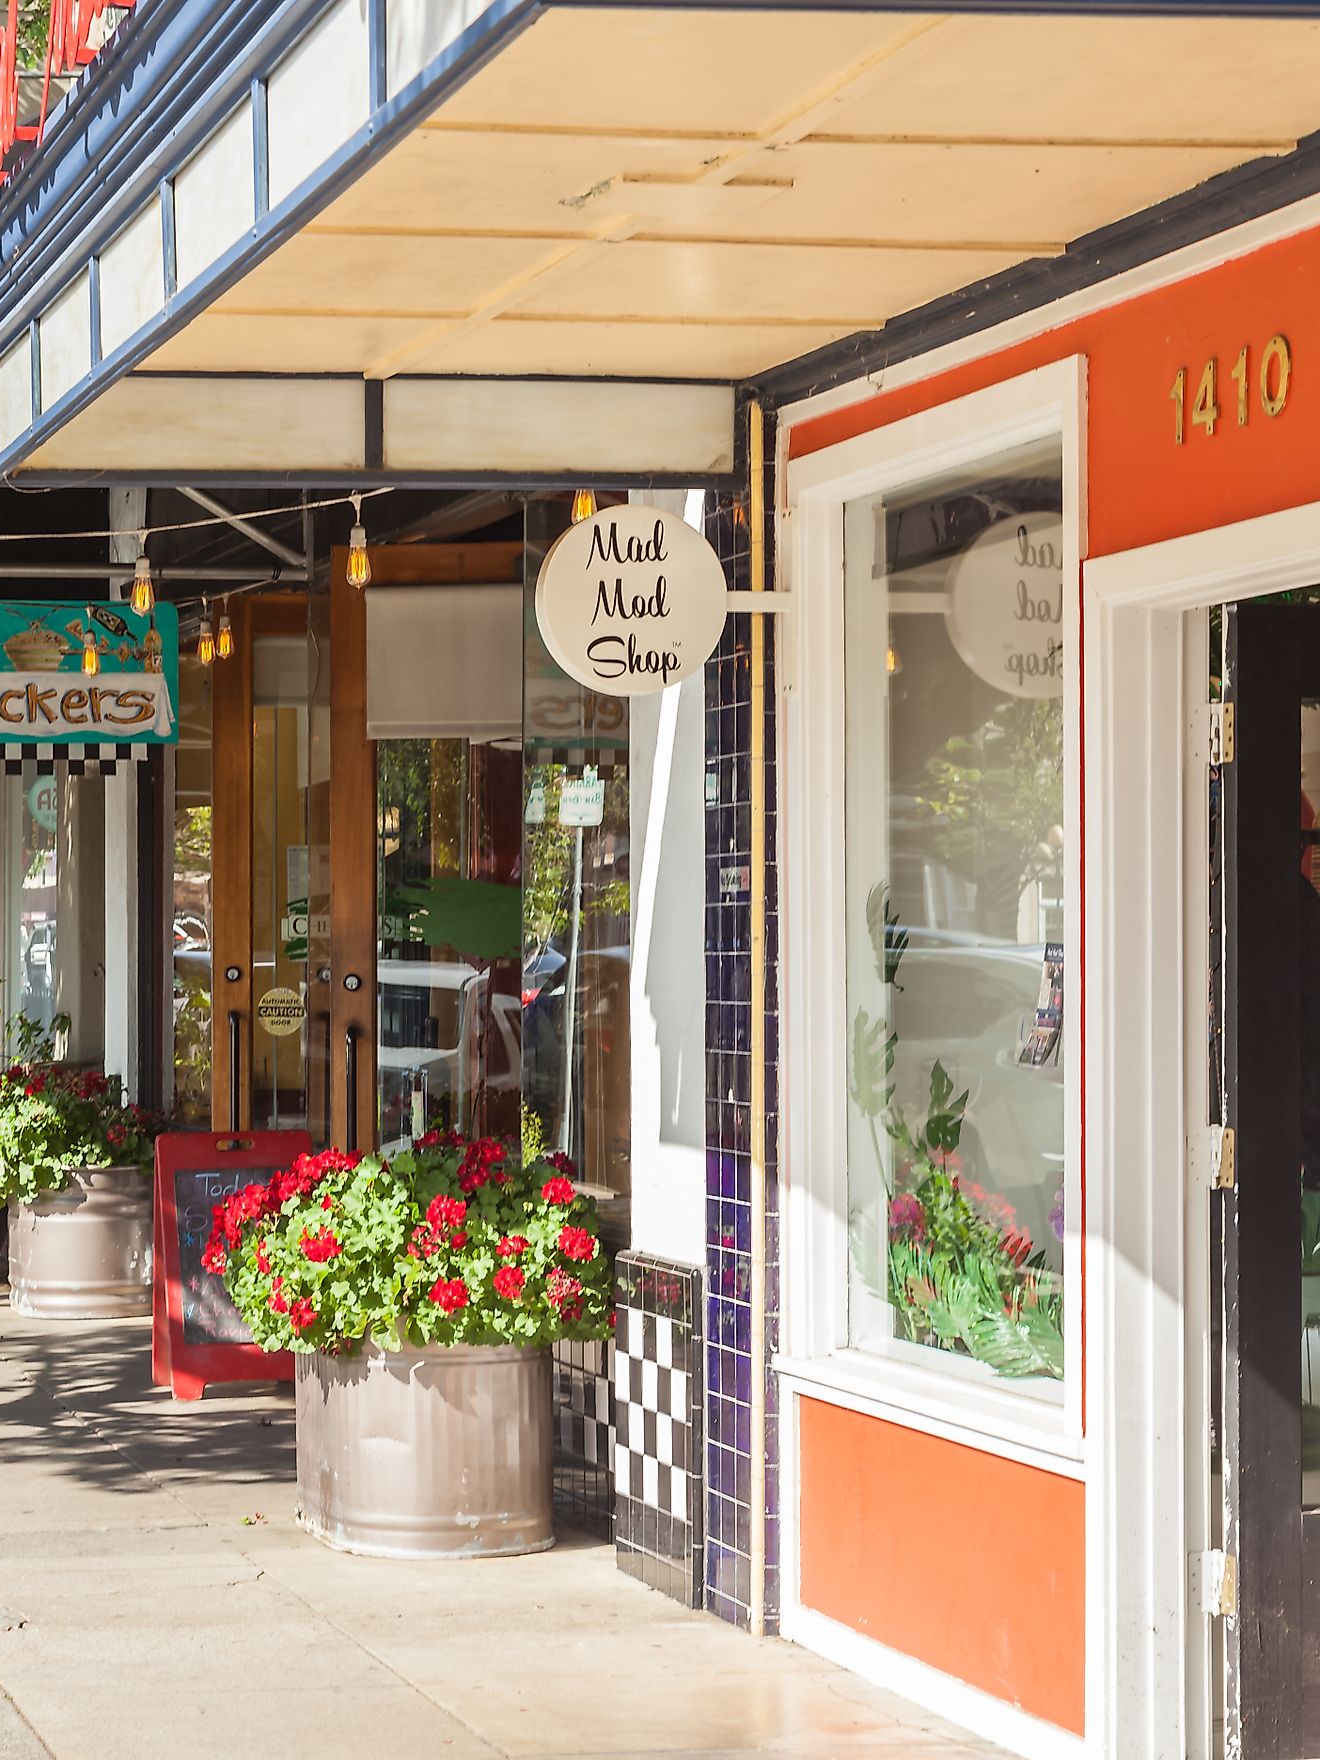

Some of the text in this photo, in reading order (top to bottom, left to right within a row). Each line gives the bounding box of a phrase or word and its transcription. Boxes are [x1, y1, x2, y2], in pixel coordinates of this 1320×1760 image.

[1169, 333, 1292, 444] 1410
[585, 519, 669, 571] Mad
[590, 575, 671, 626] Mod
[586, 633, 682, 685] Shop
[260, 1007, 304, 1017] CAUTION
